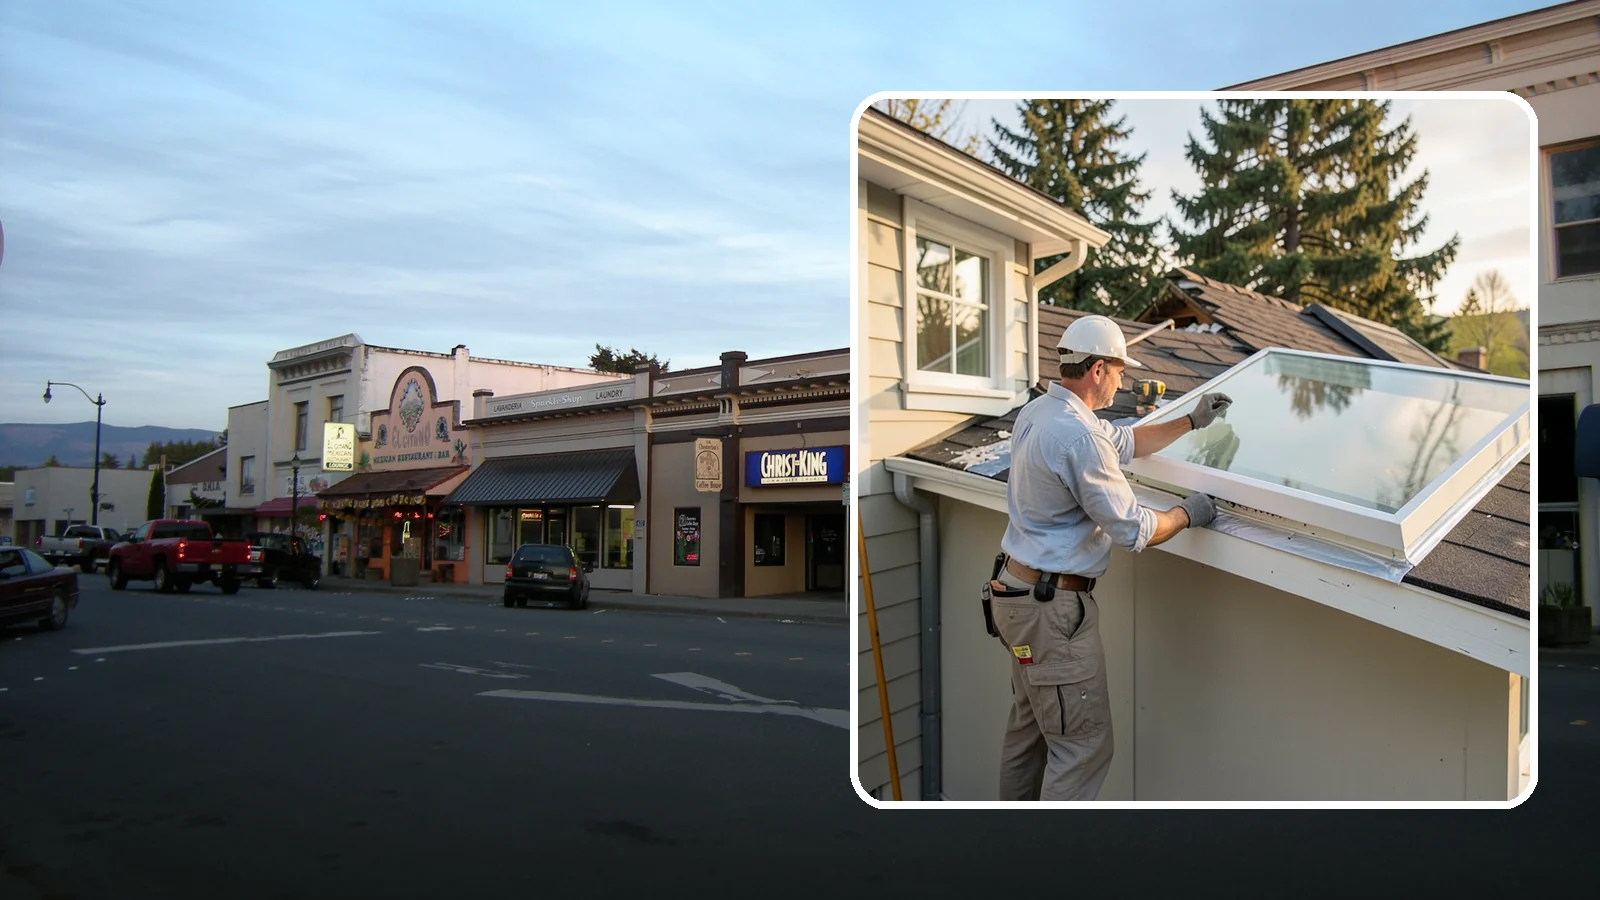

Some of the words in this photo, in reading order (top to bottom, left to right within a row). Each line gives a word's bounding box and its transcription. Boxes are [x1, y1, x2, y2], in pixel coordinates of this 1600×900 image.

[530, 397, 561, 409] Sparkle
[561, 394, 582, 406] Shop
[595, 389, 624, 400] LAUNDRY
[493, 402, 523, 412] LAVANDERIA
[373, 455, 396, 464] MEXICAN
[397, 451, 433, 462] RESTAURANT
[437, 450, 450, 459] BAR
[799, 450, 828, 476] KING
